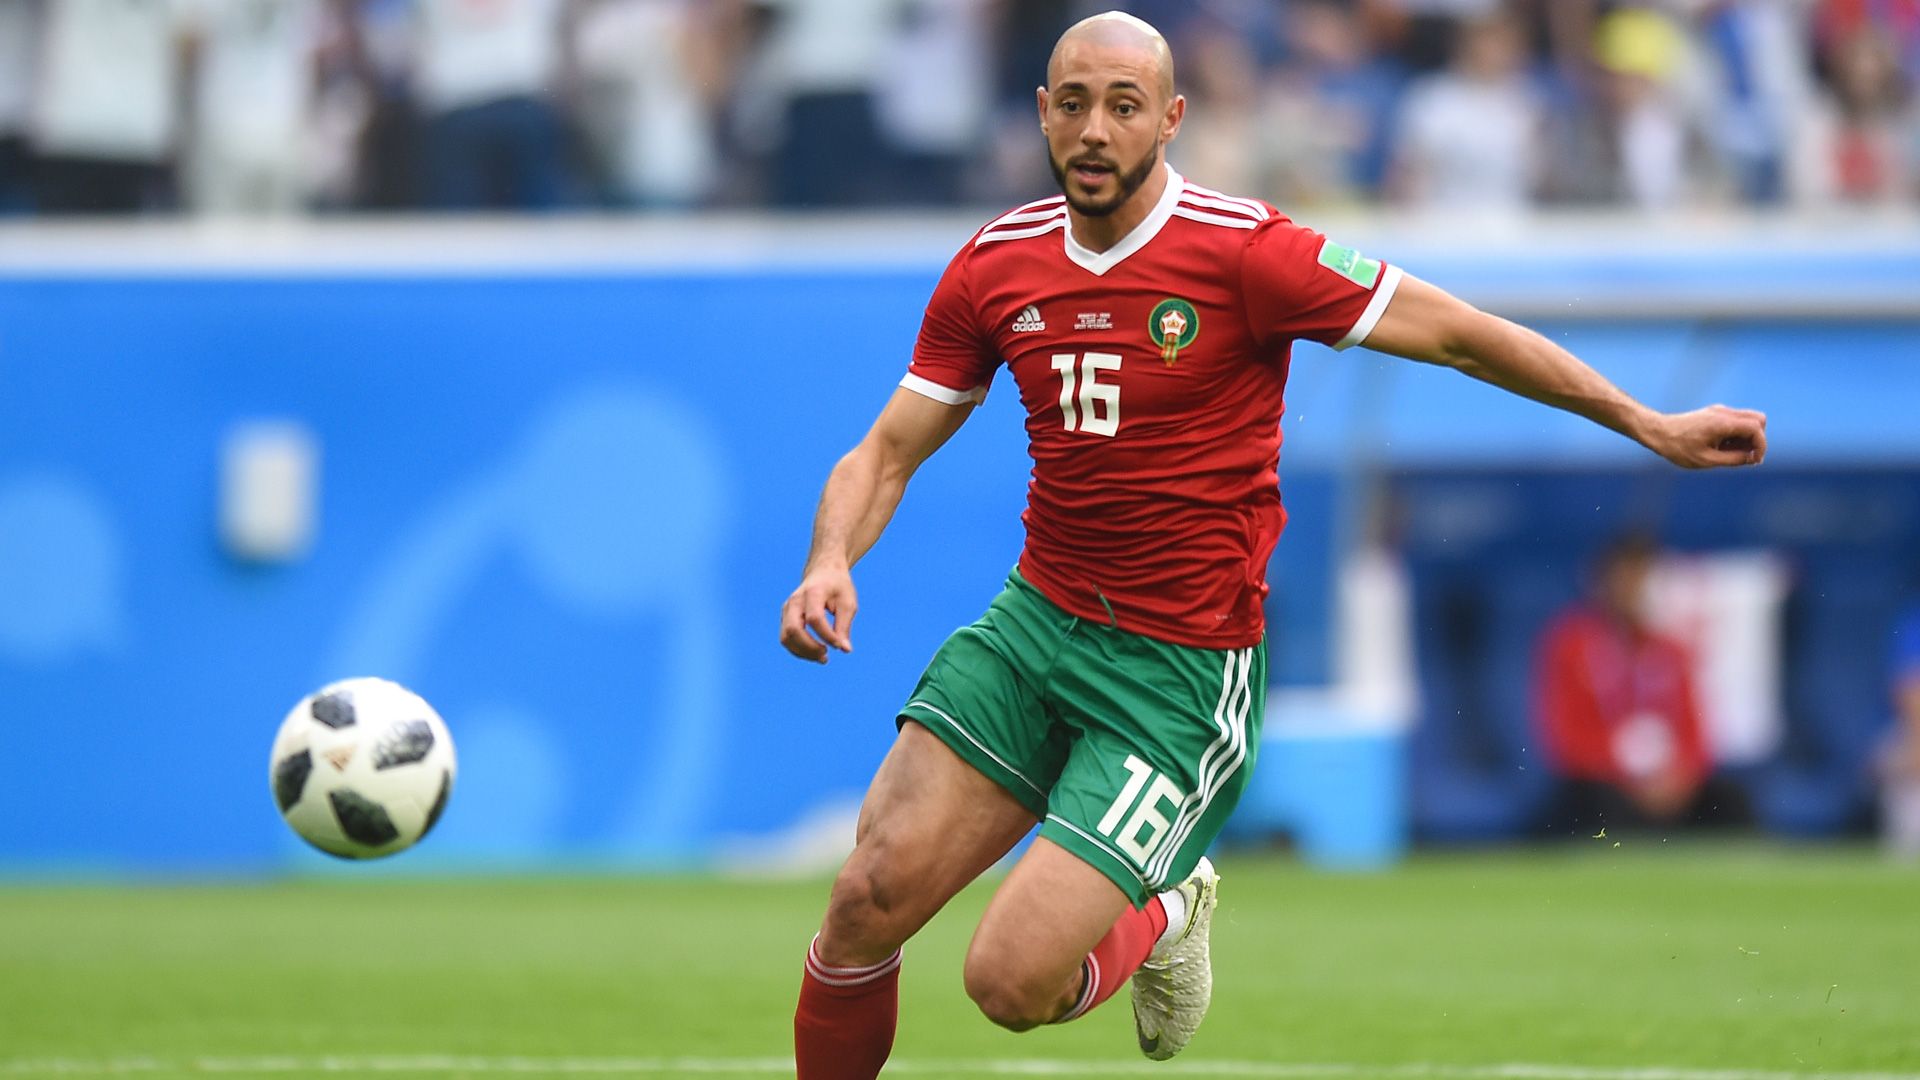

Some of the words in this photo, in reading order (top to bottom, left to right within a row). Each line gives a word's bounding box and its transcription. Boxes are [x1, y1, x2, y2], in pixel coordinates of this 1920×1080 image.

[1012, 321, 1046, 332] adidas
[1051, 352, 1123, 437] 16
[1096, 754, 1185, 868] 16
